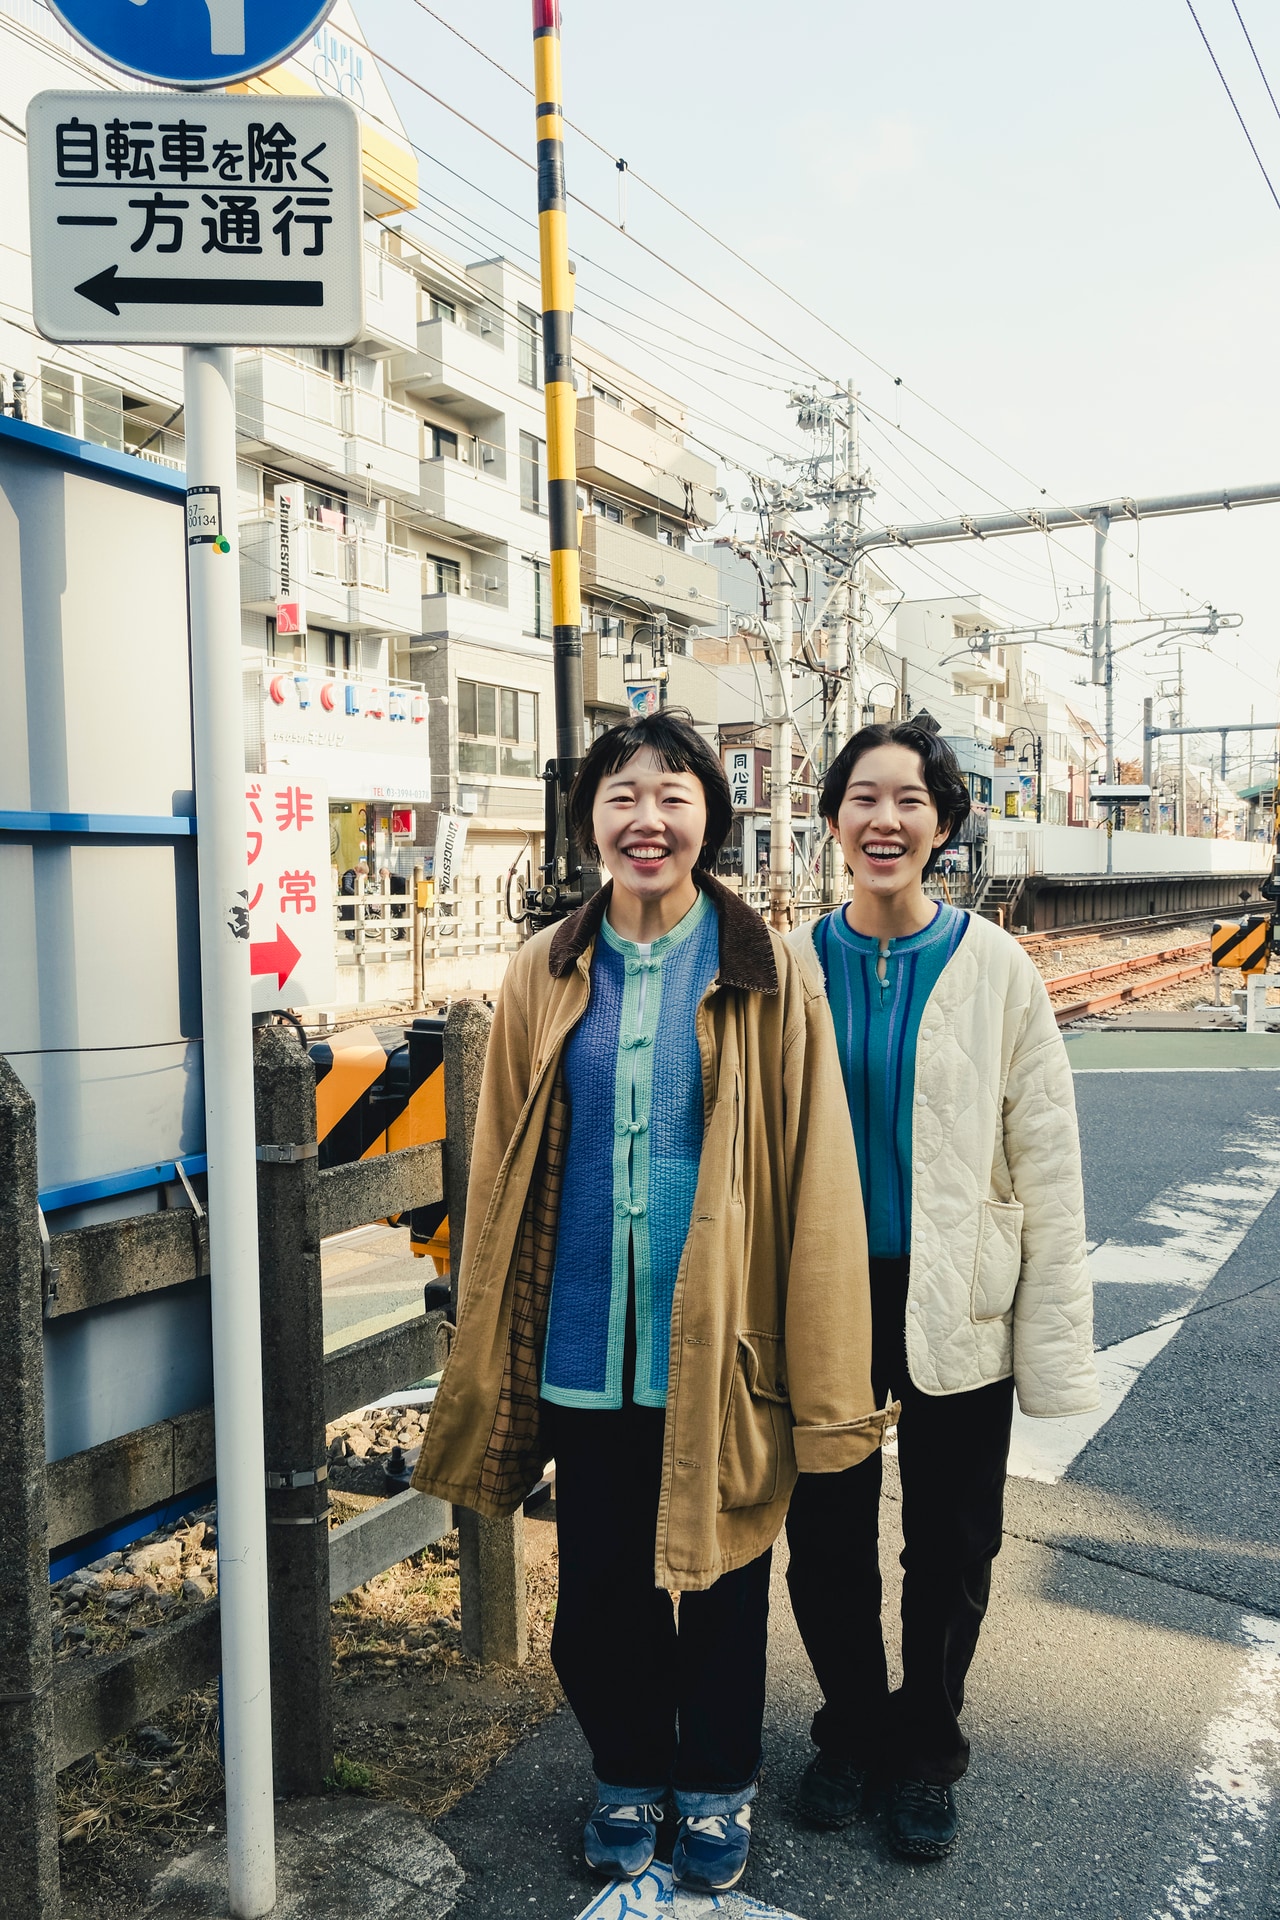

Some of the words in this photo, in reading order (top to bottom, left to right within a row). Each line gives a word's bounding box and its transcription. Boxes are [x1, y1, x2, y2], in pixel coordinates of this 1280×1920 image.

[55, 117, 330, 184] 自転車を除く
[56, 191, 333, 256] 一方通行
[279, 494, 291, 597] BRIDGESTONE
[373, 787, 385, 797] TEL
[732, 753, 750, 805] 同心房
[274, 785, 316, 915] 非常
